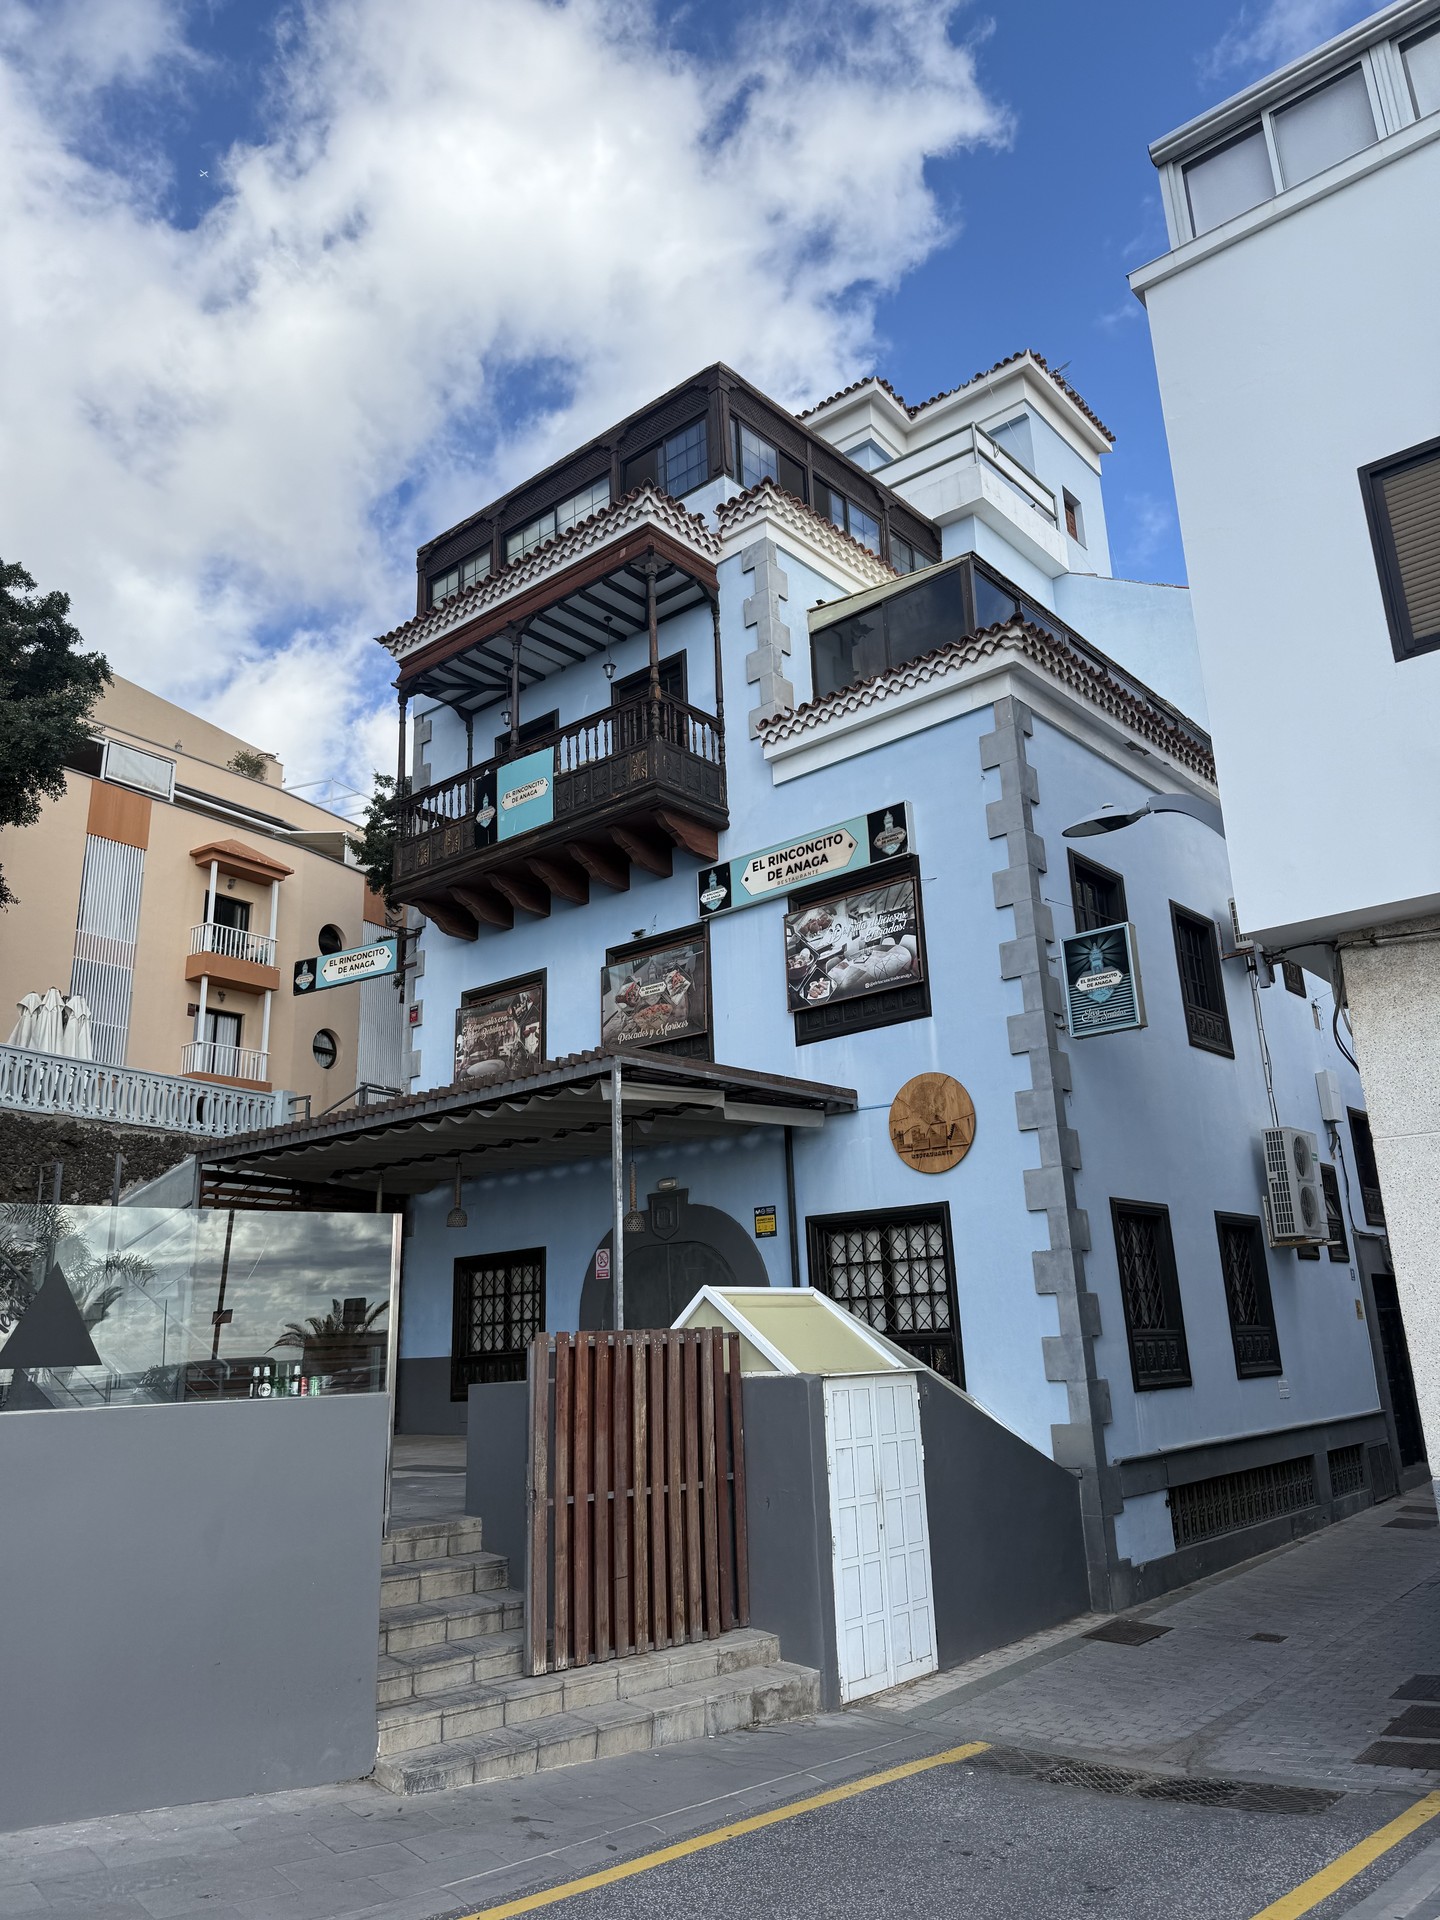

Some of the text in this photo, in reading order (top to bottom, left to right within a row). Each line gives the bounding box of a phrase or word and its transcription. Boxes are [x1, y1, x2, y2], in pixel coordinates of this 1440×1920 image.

[512, 780, 544, 796] RINCONCITO
[752, 833, 843, 872] EL RINCONCITO
[767, 854, 828, 882] DE ANAGA
[777, 869, 819, 885] RESTAURANTE
[339, 948, 385, 964] RINCONCITO
[349, 960, 375, 971] ANAGA
[1087, 973, 1117, 982] RINCONCITO
[618, 1020, 688, 1044] Pescados y Mariscos
